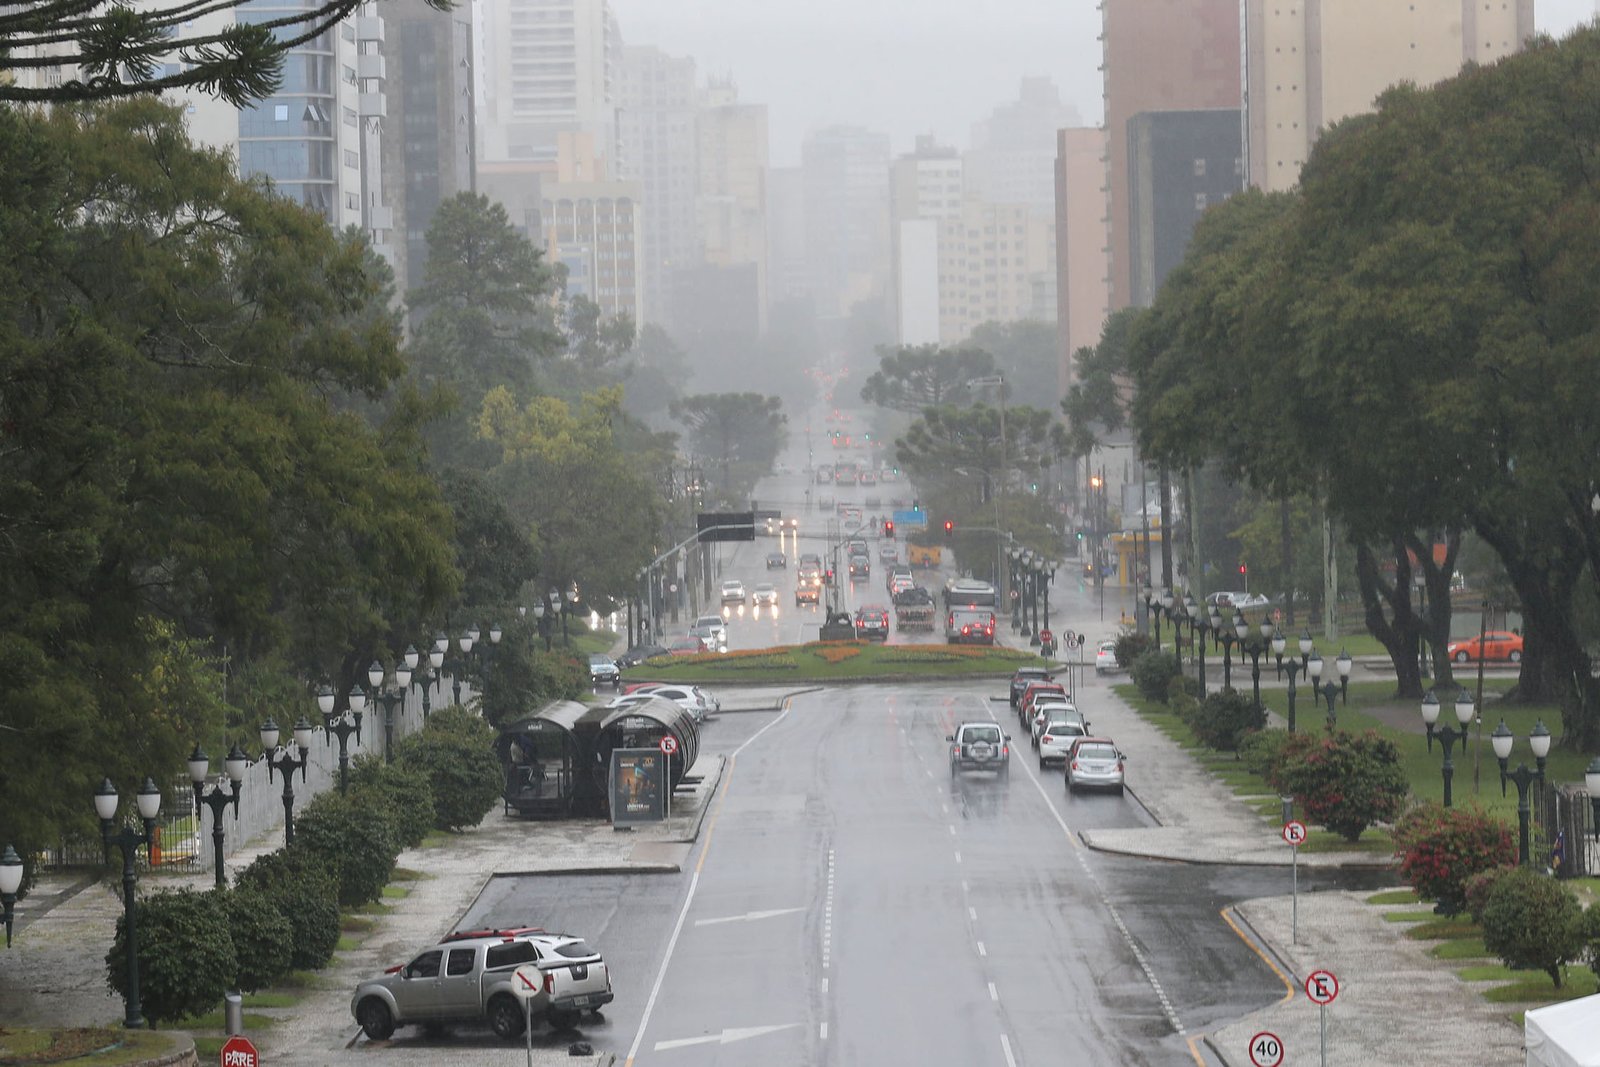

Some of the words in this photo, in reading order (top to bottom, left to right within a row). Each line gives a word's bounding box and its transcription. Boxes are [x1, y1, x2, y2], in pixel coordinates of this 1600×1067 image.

[1316, 978, 1328, 997] E
[1255, 1040, 1278, 1057] 40
[225, 1052, 254, 1067] PARE
